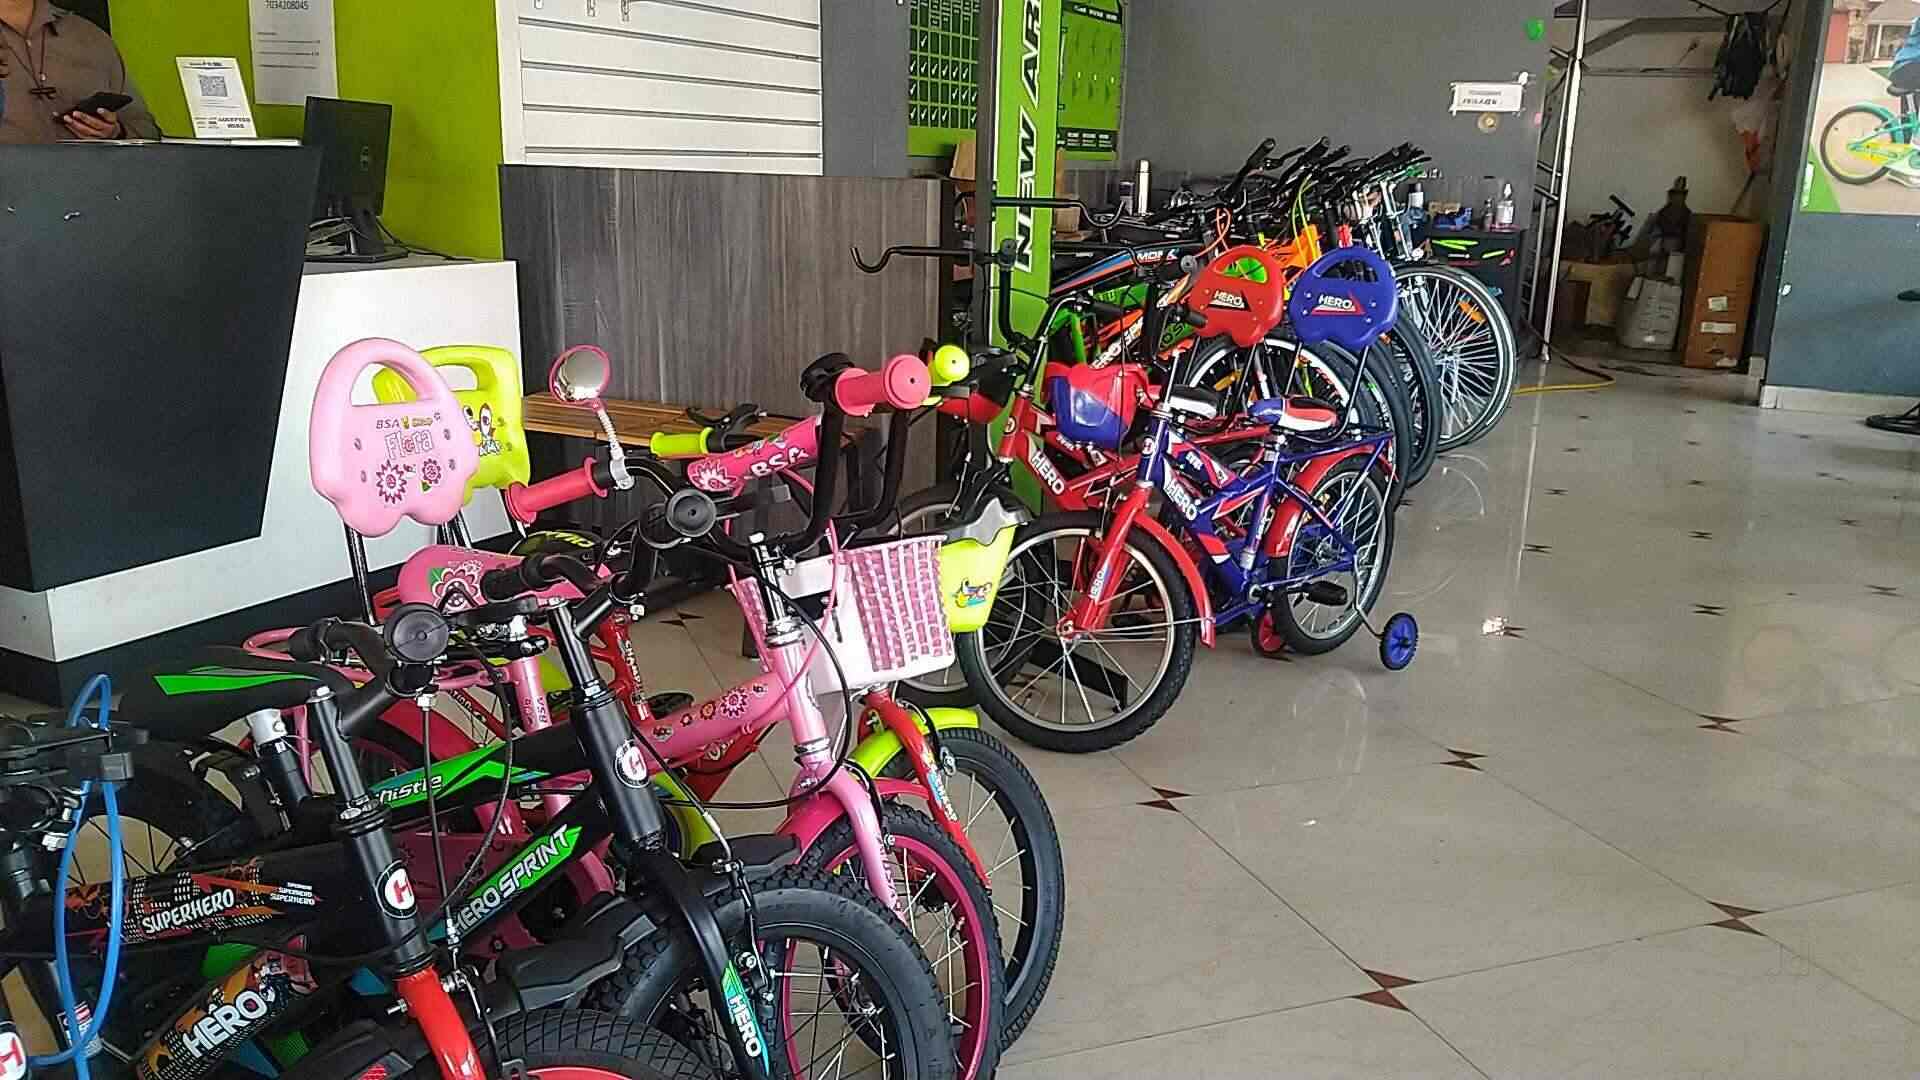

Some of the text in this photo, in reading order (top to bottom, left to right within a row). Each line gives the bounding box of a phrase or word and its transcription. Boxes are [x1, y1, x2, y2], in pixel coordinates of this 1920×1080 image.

[1014, 105, 1039, 272] NEW
[1214, 289, 1243, 306] HERO
[1318, 293, 1353, 310] HERO
[1031, 450, 1065, 495] HERO
[1163, 477, 1198, 521] HERO
[142, 888, 235, 934] SUPERHERO
[182, 989, 268, 1059] HERO
[728, 995, 763, 1058] HERO
